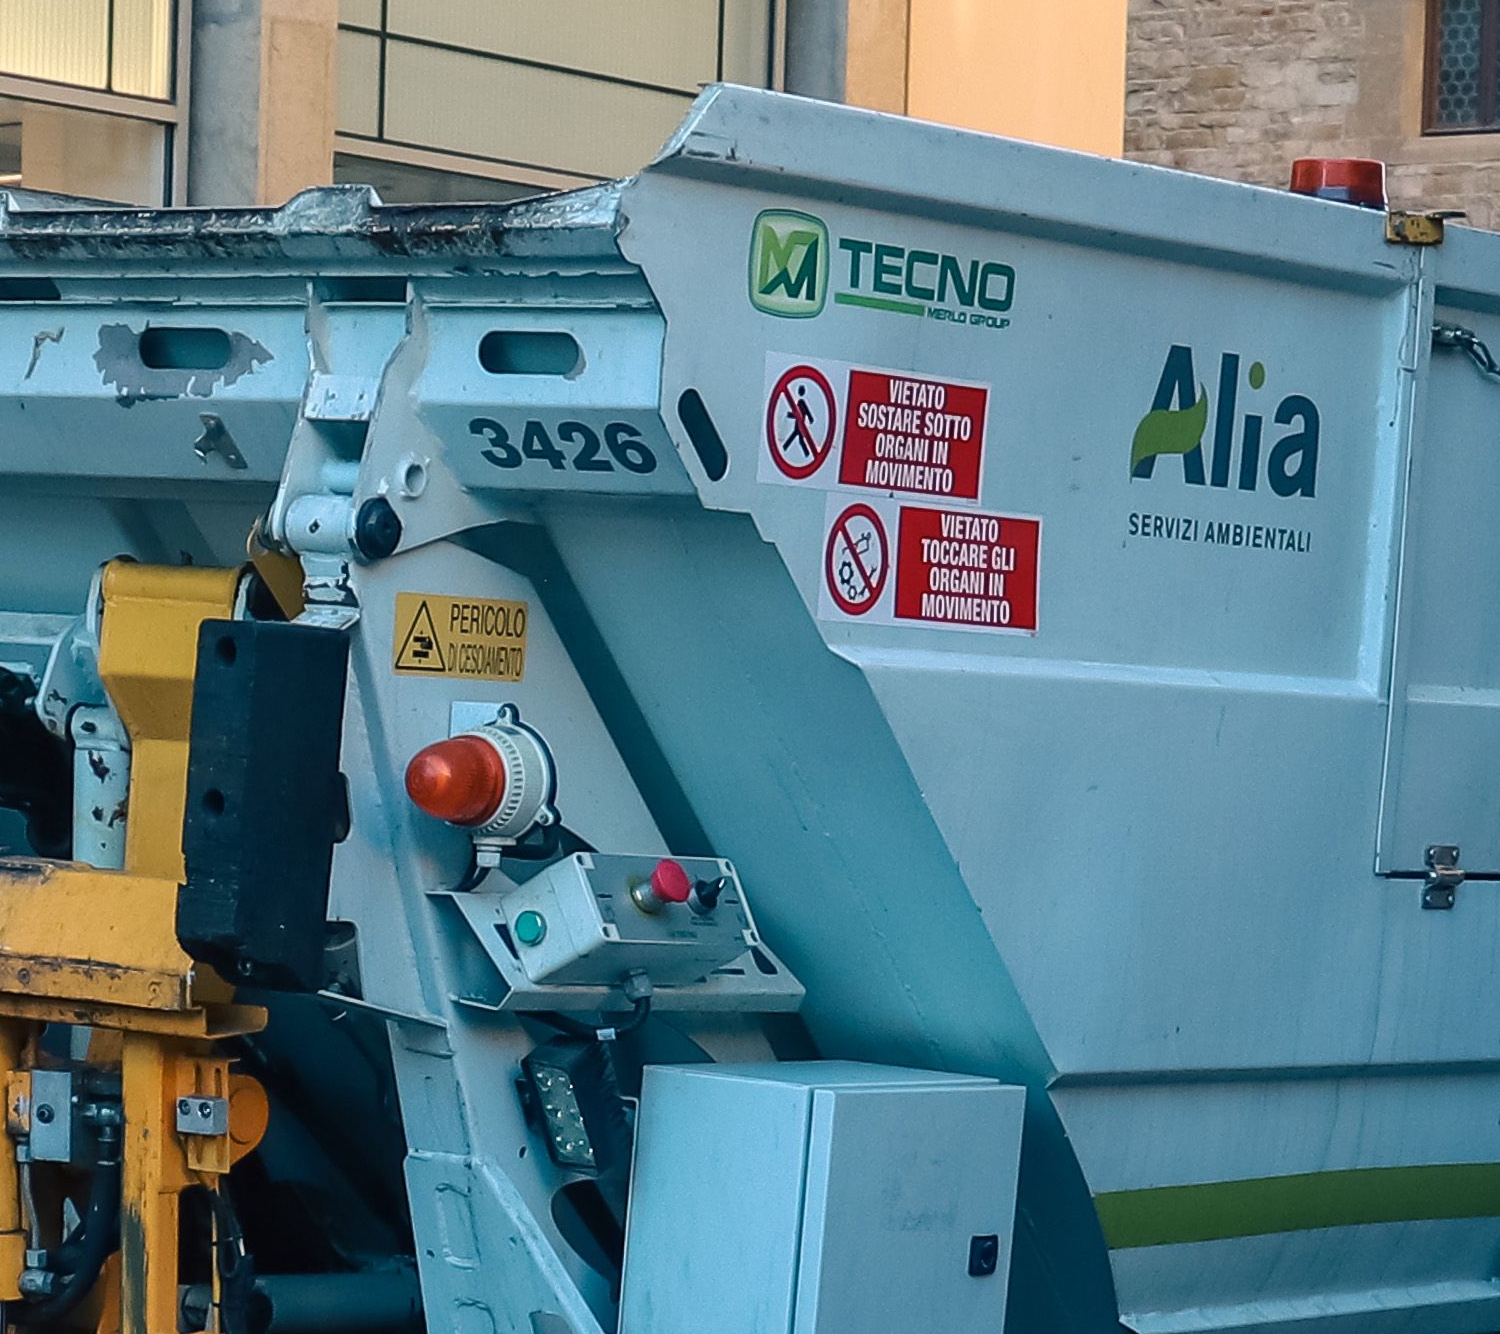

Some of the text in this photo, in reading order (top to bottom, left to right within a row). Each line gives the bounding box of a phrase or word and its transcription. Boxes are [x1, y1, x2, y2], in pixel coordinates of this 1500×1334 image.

[839, 237, 1016, 312] TECNO
[927, 307, 1011, 329] MERLO GROUP
[889, 378, 945, 410] VIETATO
[858, 403, 972, 441] SOSTARE SOTTO
[1130, 344, 1319, 499] Alia
[468, 417, 657, 475] 3426
[875, 432, 949, 466] ORGANI IN
[865, 459, 954, 493] MOVIMENTO
[941, 513, 999, 544] VIETATO
[1129, 512, 1312, 553] SERVIZI AMBIENTALI
[921, 538, 1015, 571] TOCCARE GLI
[929, 566, 1005, 597] ORGANI IN
[450, 603, 526, 638] PERICOLO
[921, 593, 1010, 625] MOVIMENTO
[448, 642, 523, 677] DI CESOIAMENTO
